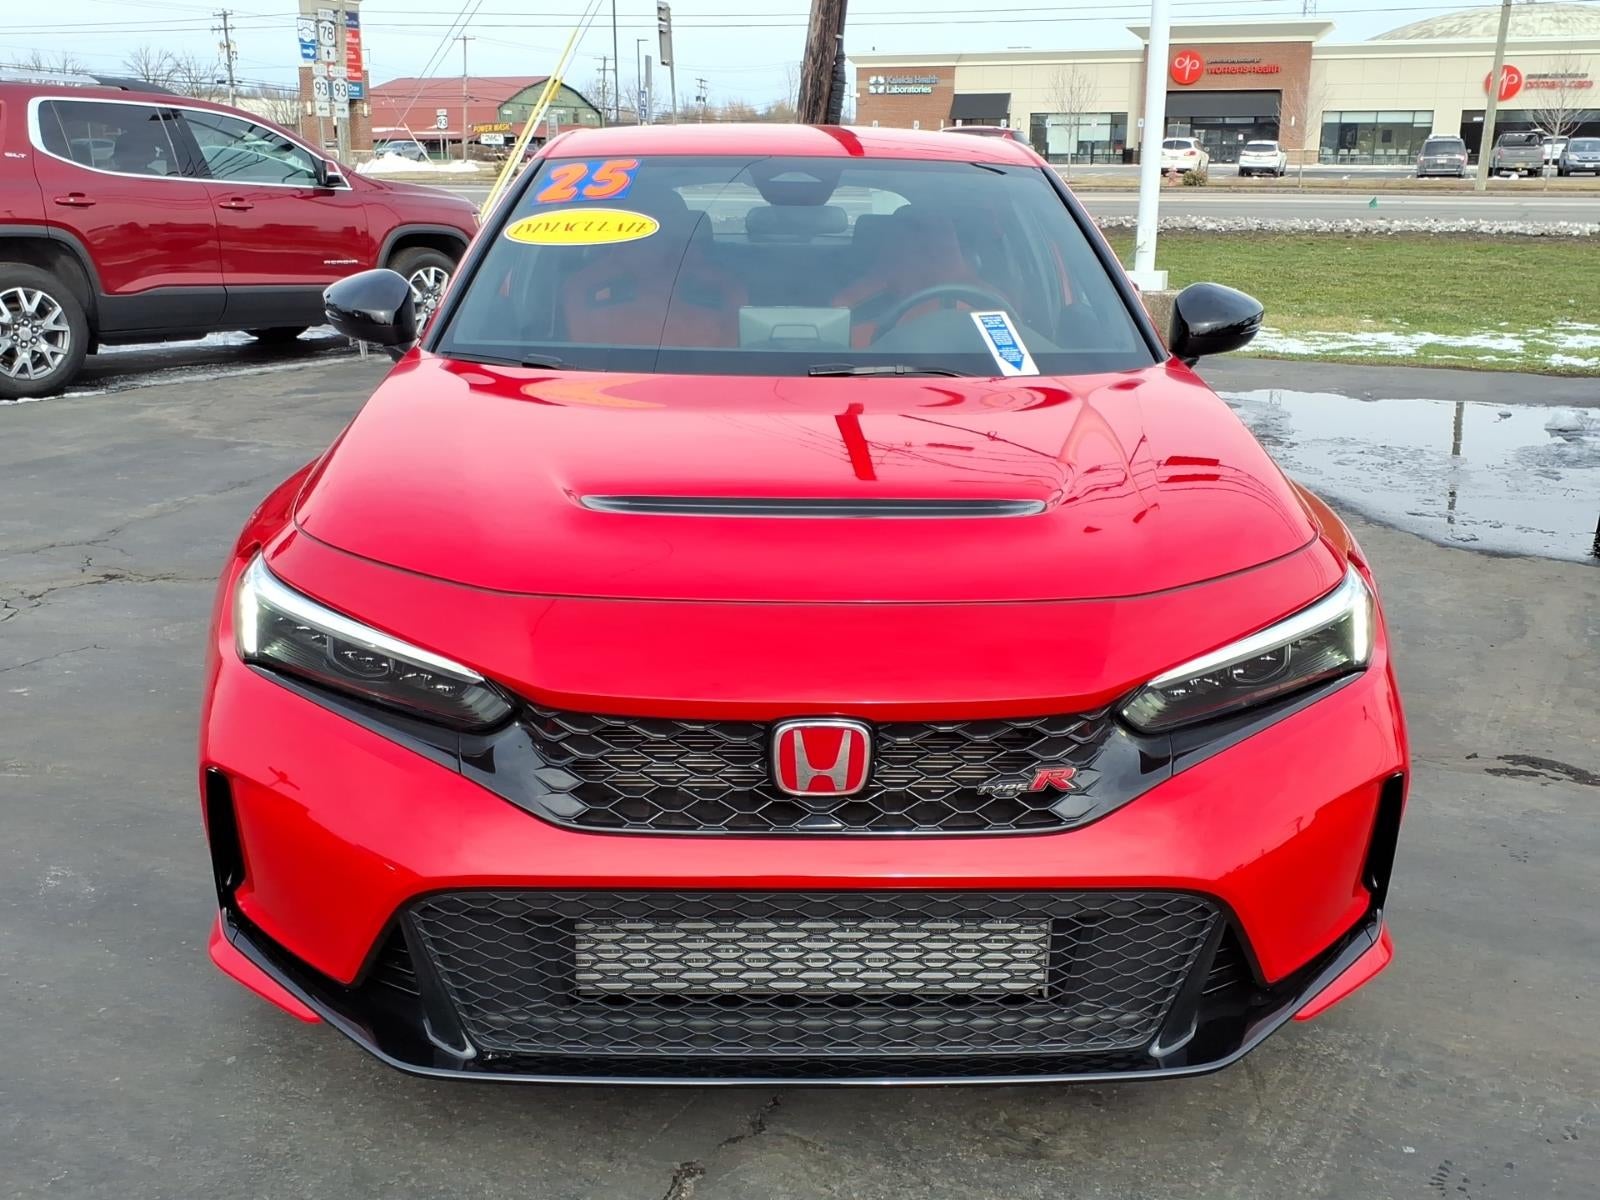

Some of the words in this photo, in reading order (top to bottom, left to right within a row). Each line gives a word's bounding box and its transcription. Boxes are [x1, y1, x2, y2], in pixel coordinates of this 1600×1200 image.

[320, 25, 334, 41] 78
[314, 81, 328, 96] 93
[334, 83, 347, 98] 93
[886, 85, 933, 94] Laboratories
[438, 117, 447, 127] 93
[536, 159, 640, 203] 25
[1028, 766, 1081, 793] R
